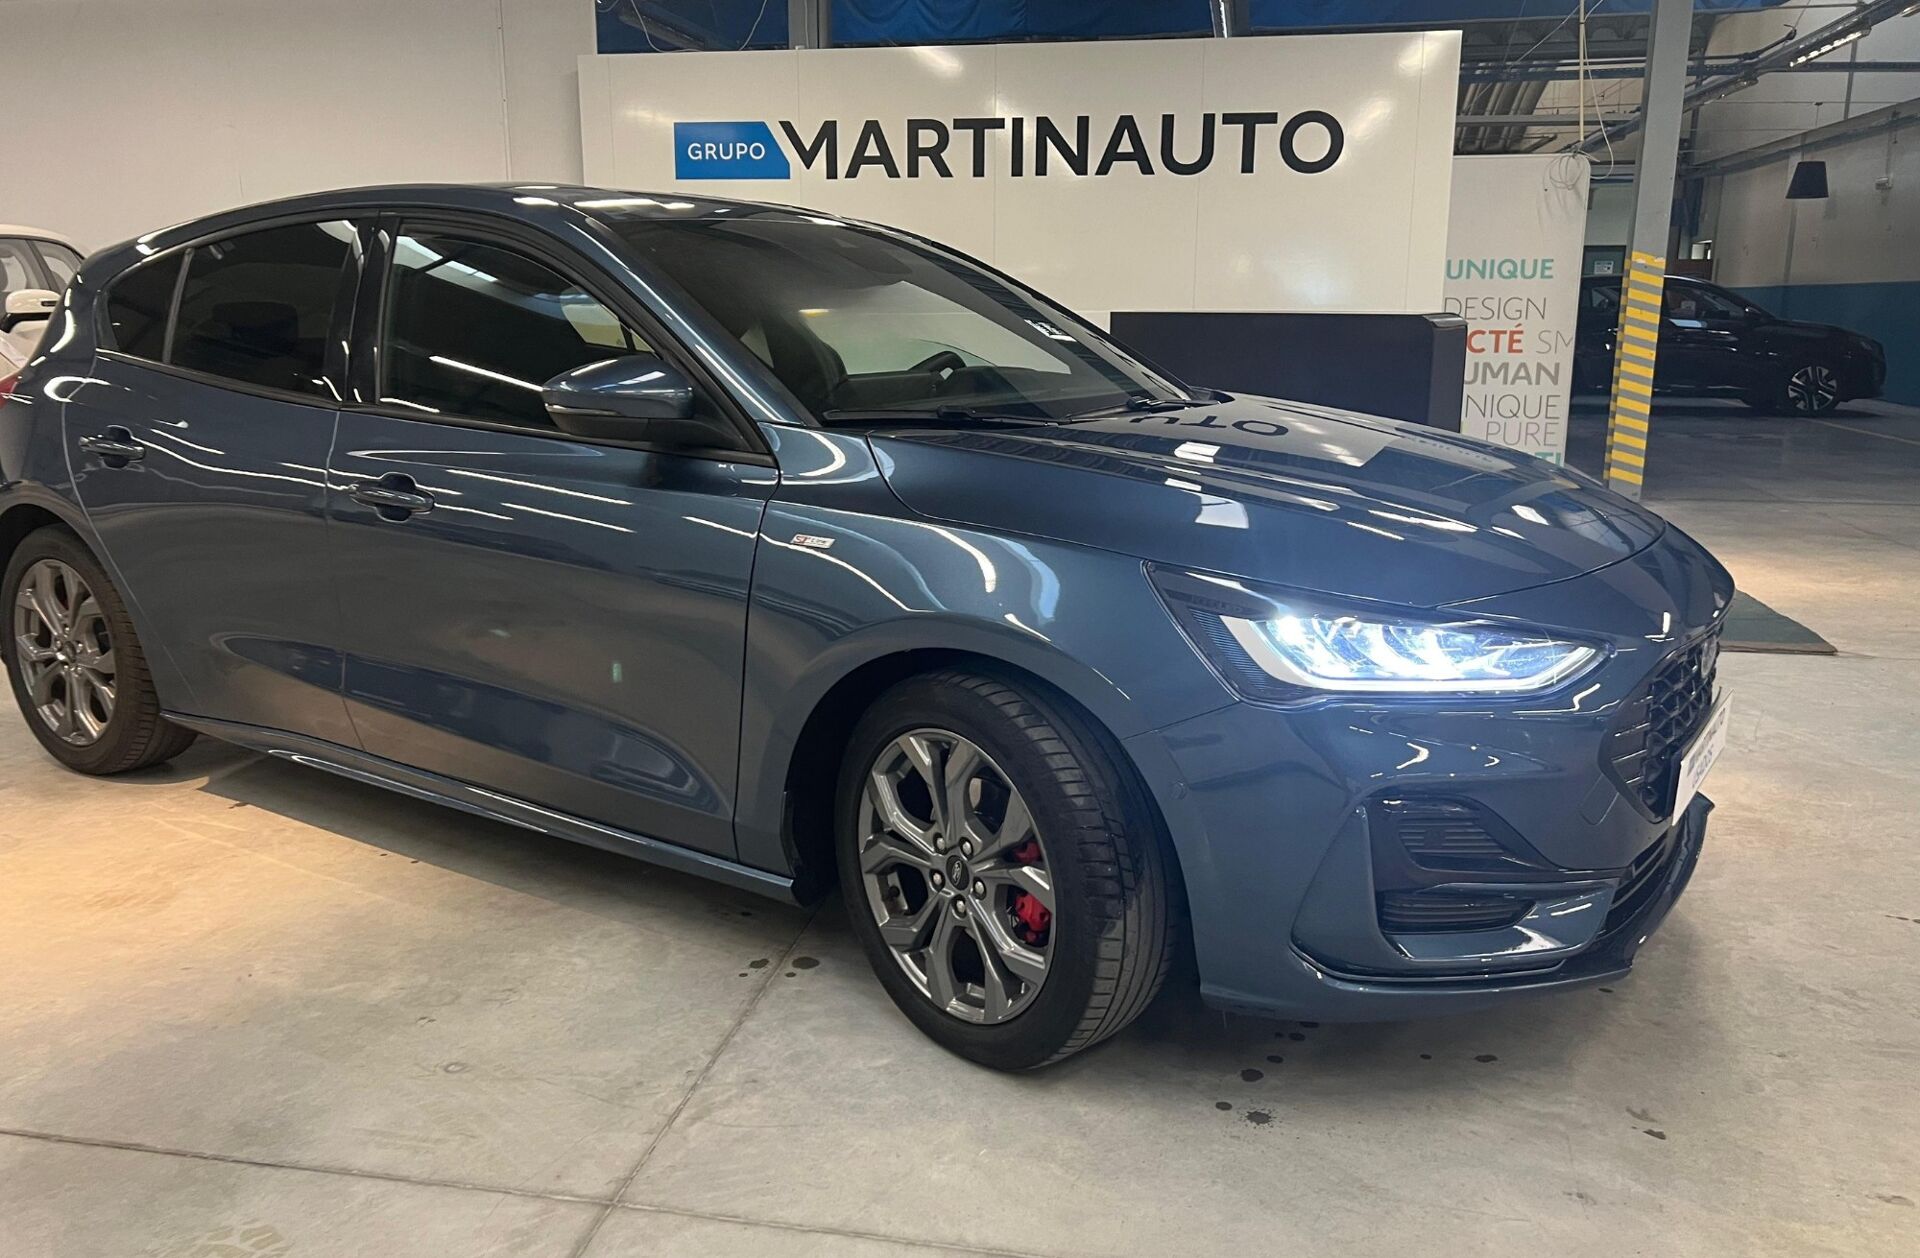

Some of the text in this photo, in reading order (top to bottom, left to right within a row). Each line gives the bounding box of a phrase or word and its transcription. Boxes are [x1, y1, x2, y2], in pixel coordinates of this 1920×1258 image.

[686, 110, 1345, 180] GRUPO MARTINAUTO
[1445, 258, 1554, 280] UNIQUE
[1443, 296, 1547, 321] DESIGN
[1466, 322, 1574, 355] CTÉ SM
[1463, 361, 1561, 386] UMAN
[1464, 393, 1561, 420] NIQUE
[1485, 421, 1560, 447] PURE
